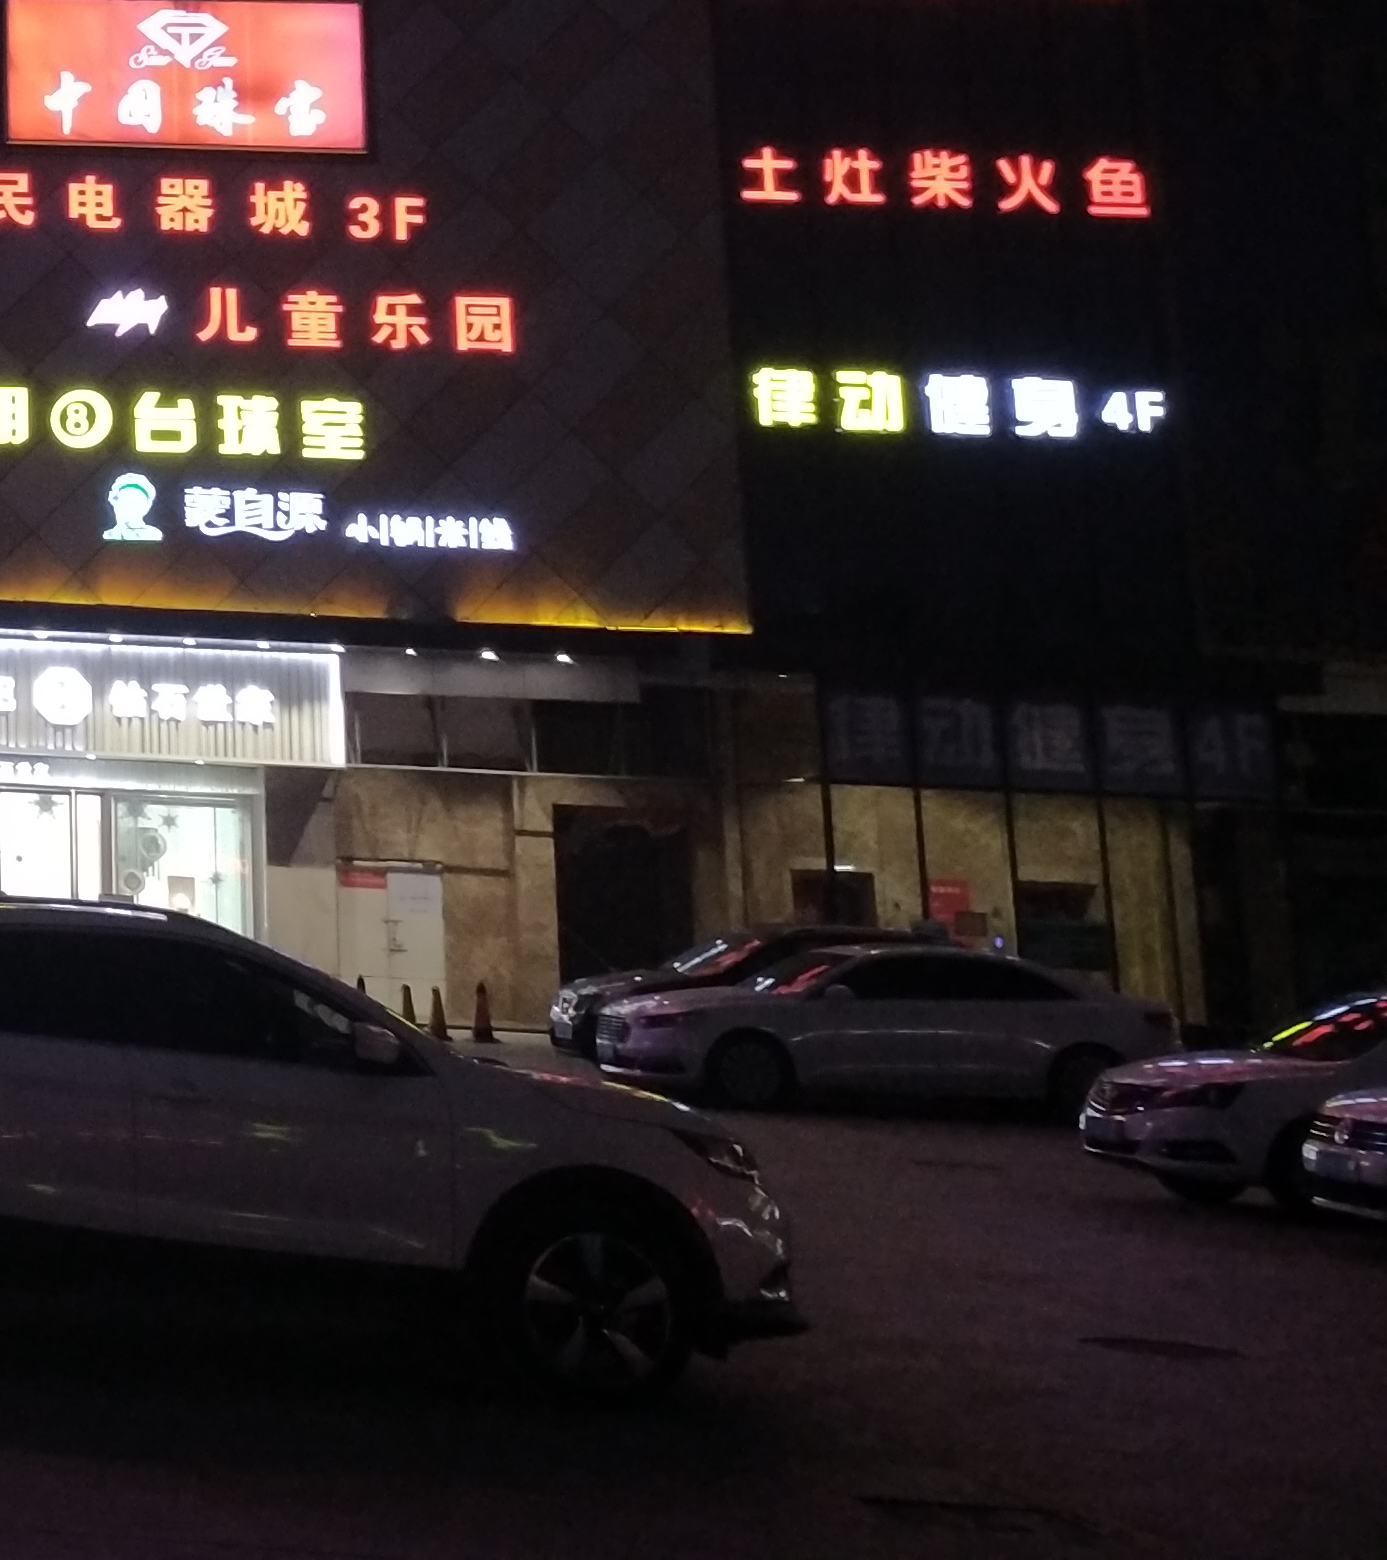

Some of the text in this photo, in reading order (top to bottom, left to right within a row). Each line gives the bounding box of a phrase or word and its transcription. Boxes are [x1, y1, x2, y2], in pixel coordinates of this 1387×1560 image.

[43, 70, 329, 138] 中国珠宝
[739, 145, 1153, 219] 土灶柴火鱼
[195, 286, 517, 354] 儿童乐园
[183, 485, 327, 539] 蒙自源
